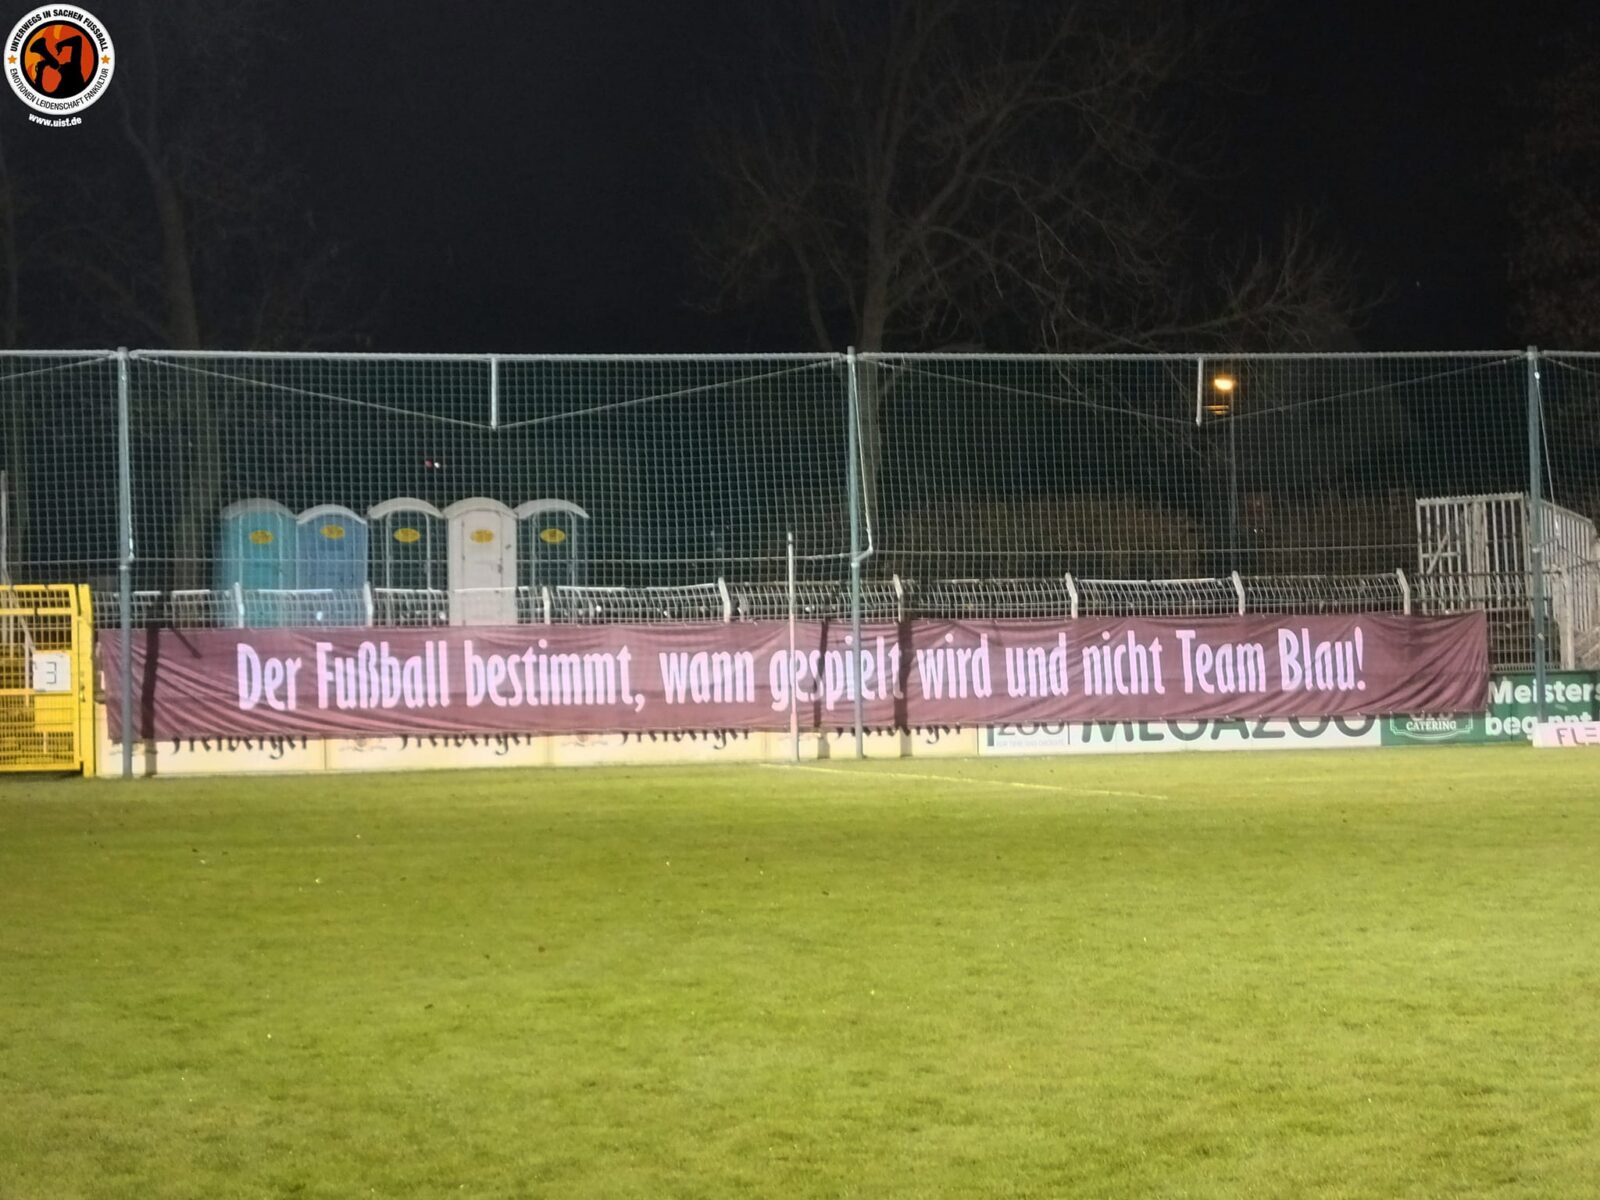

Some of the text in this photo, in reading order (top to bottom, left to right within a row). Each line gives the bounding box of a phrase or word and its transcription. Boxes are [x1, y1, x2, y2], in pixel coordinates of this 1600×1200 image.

[236, 627, 1367, 713] Der Fußball bestimmt, wann gespielt wird und nicht Team Blau!
[1406, 720, 1457, 732] CATERING
